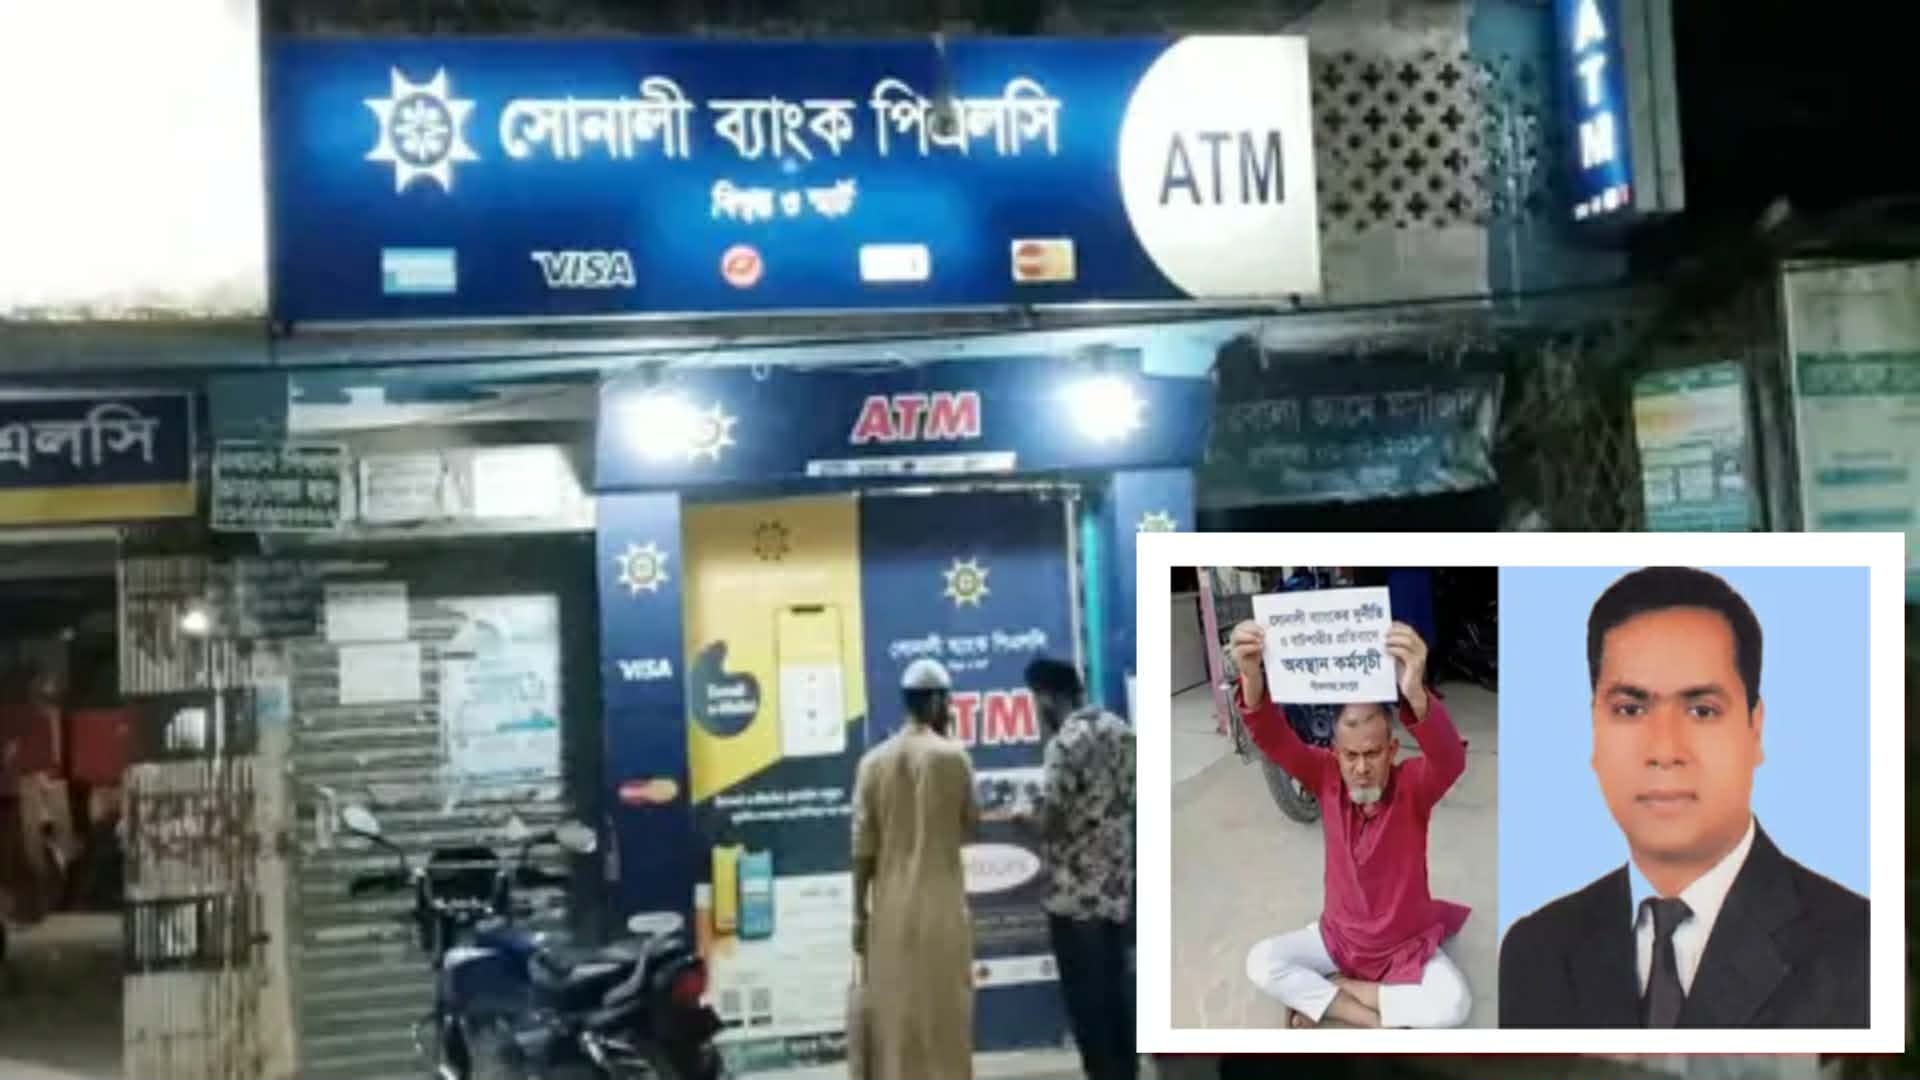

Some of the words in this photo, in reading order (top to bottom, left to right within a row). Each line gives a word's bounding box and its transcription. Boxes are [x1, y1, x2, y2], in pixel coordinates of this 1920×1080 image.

[500, 76, 695, 161] সোনালী
[708, 96, 856, 161] ব্যাংক
[870, 77, 1061, 158] পিএলসি
[1158, 130, 1286, 206] ATM
[532, 250, 637, 288] VISA
[850, 391, 983, 445] ATM
[617, 657, 674, 682] VISA
[1281, 656, 1330, 676] অবস্থান
[1333, 648, 1382, 676] কর্মসূচী
[948, 686, 1042, 746] TM
